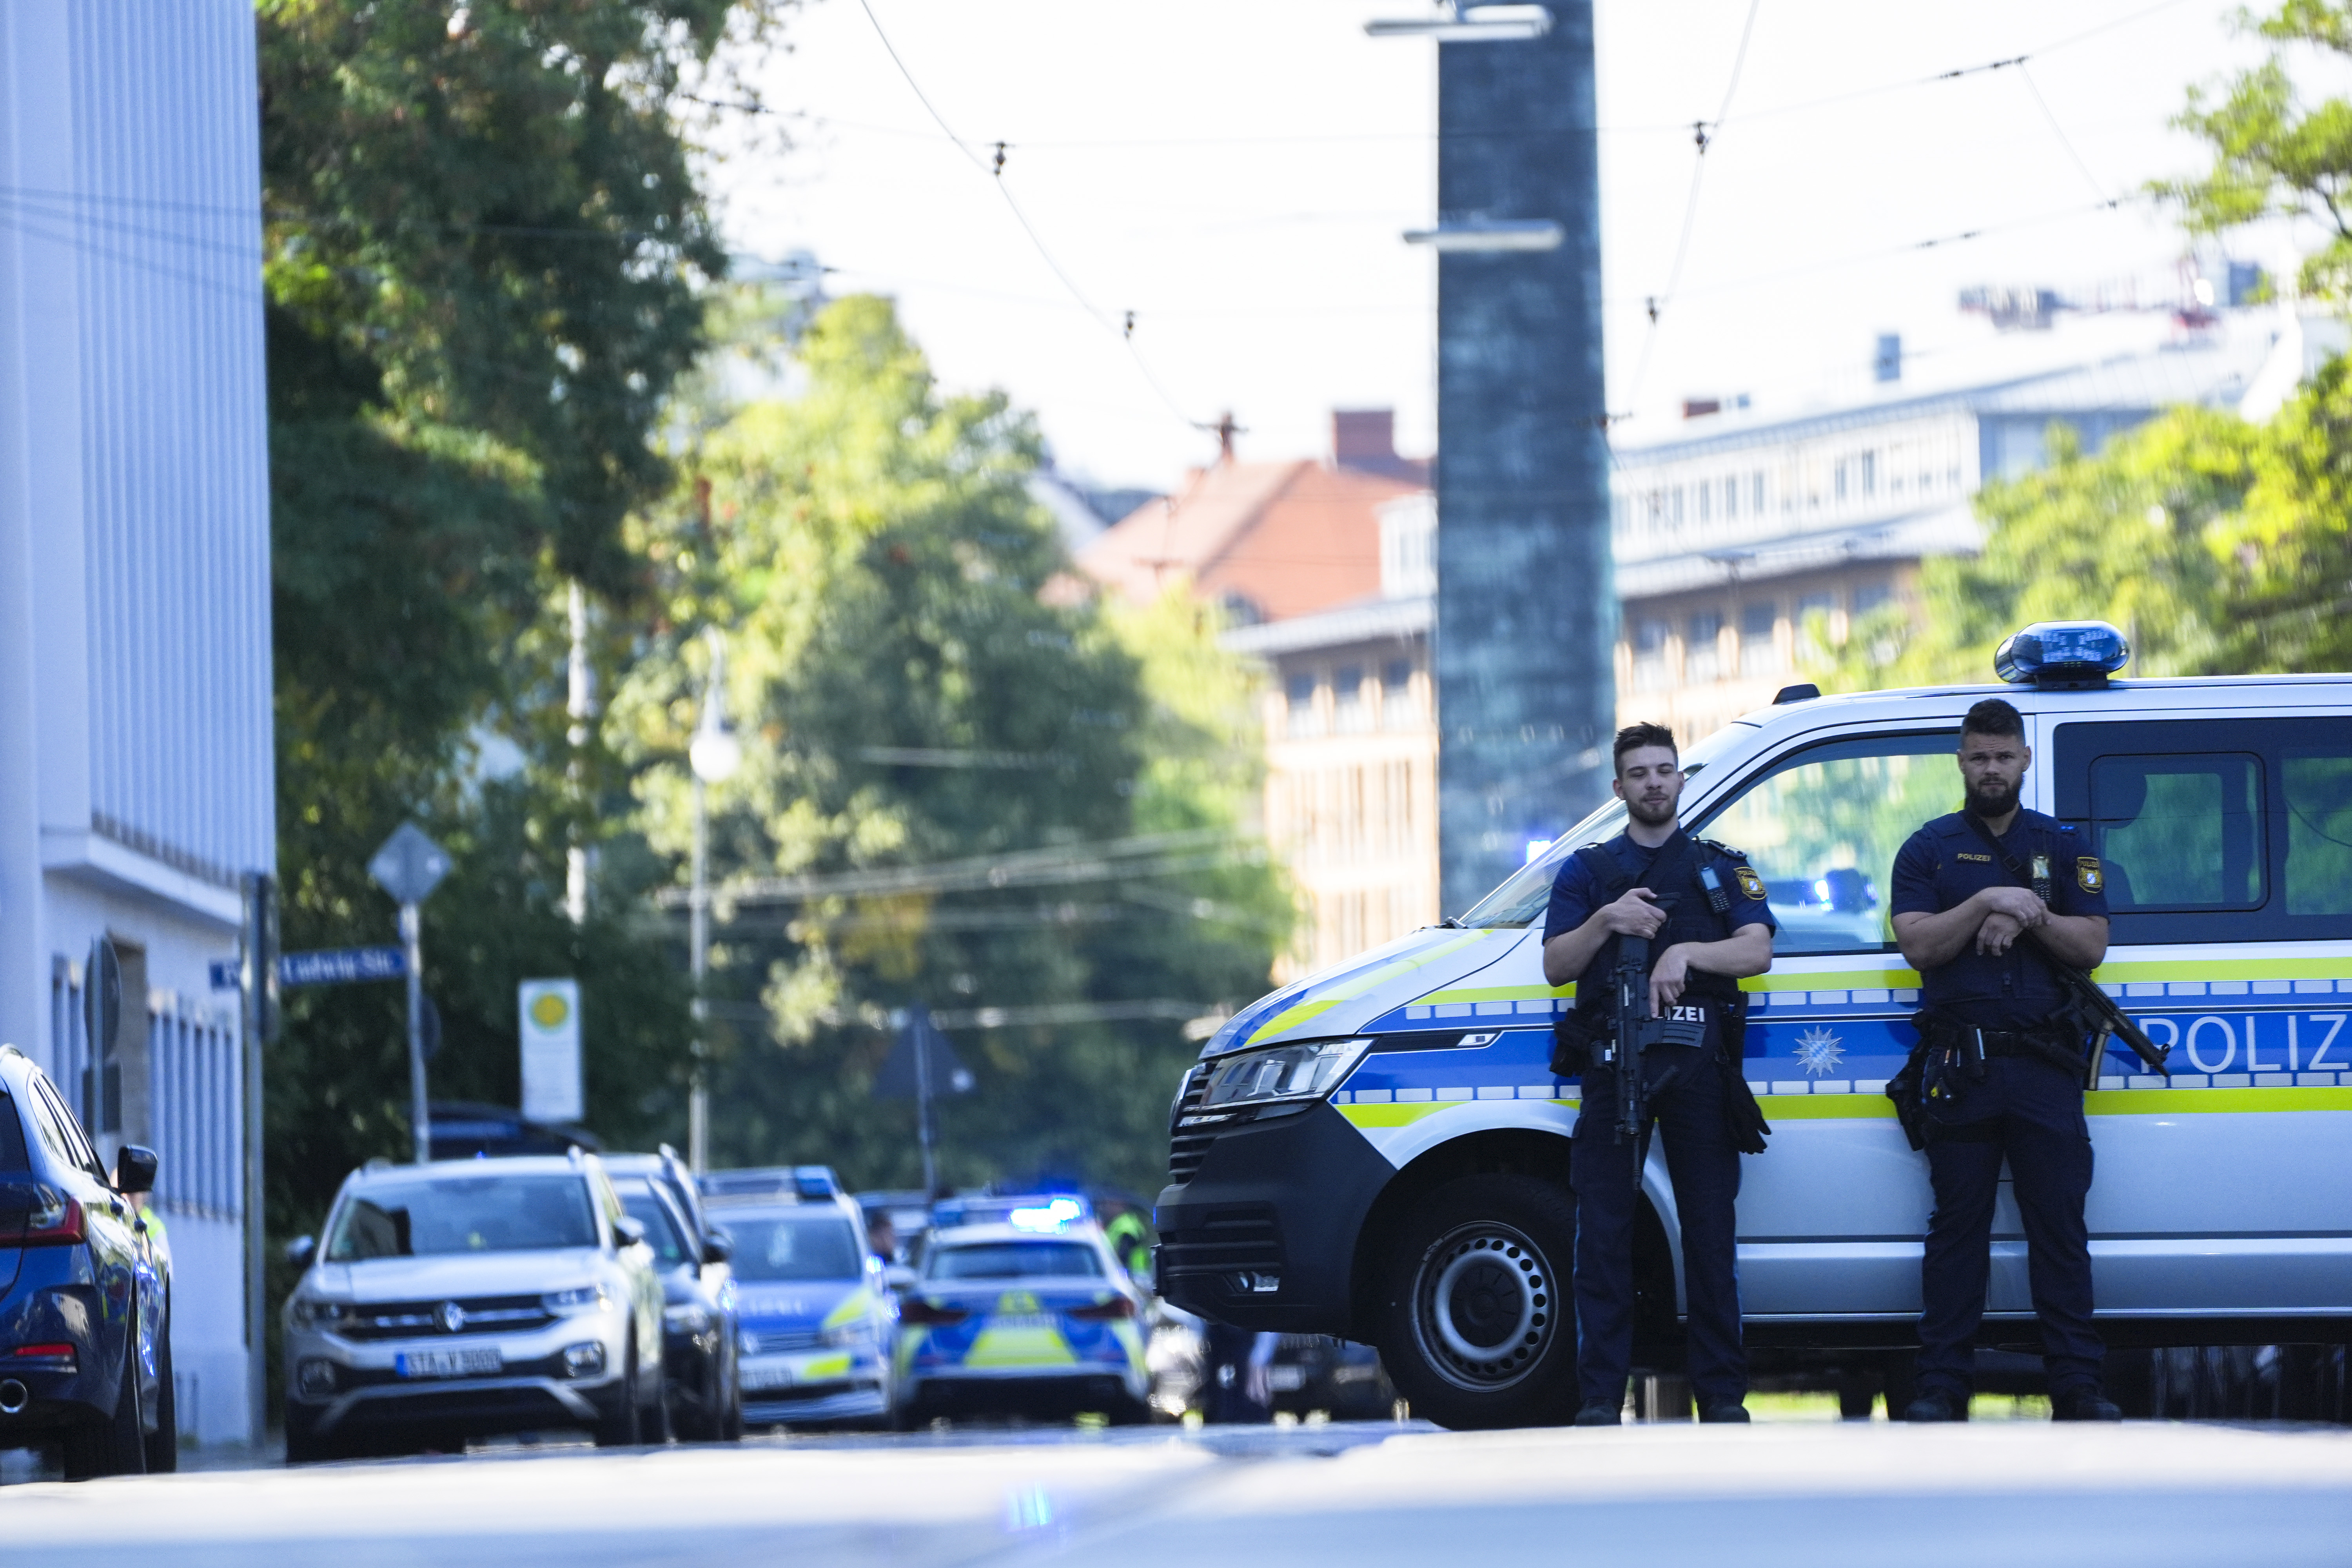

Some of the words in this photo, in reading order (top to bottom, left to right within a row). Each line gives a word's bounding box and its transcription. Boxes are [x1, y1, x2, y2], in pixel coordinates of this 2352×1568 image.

[1958, 853, 1991, 861] POLIZEI
[1657, 1006, 1705, 1022] IZEI
[2138, 1014, 2350, 1073] POLIZ
